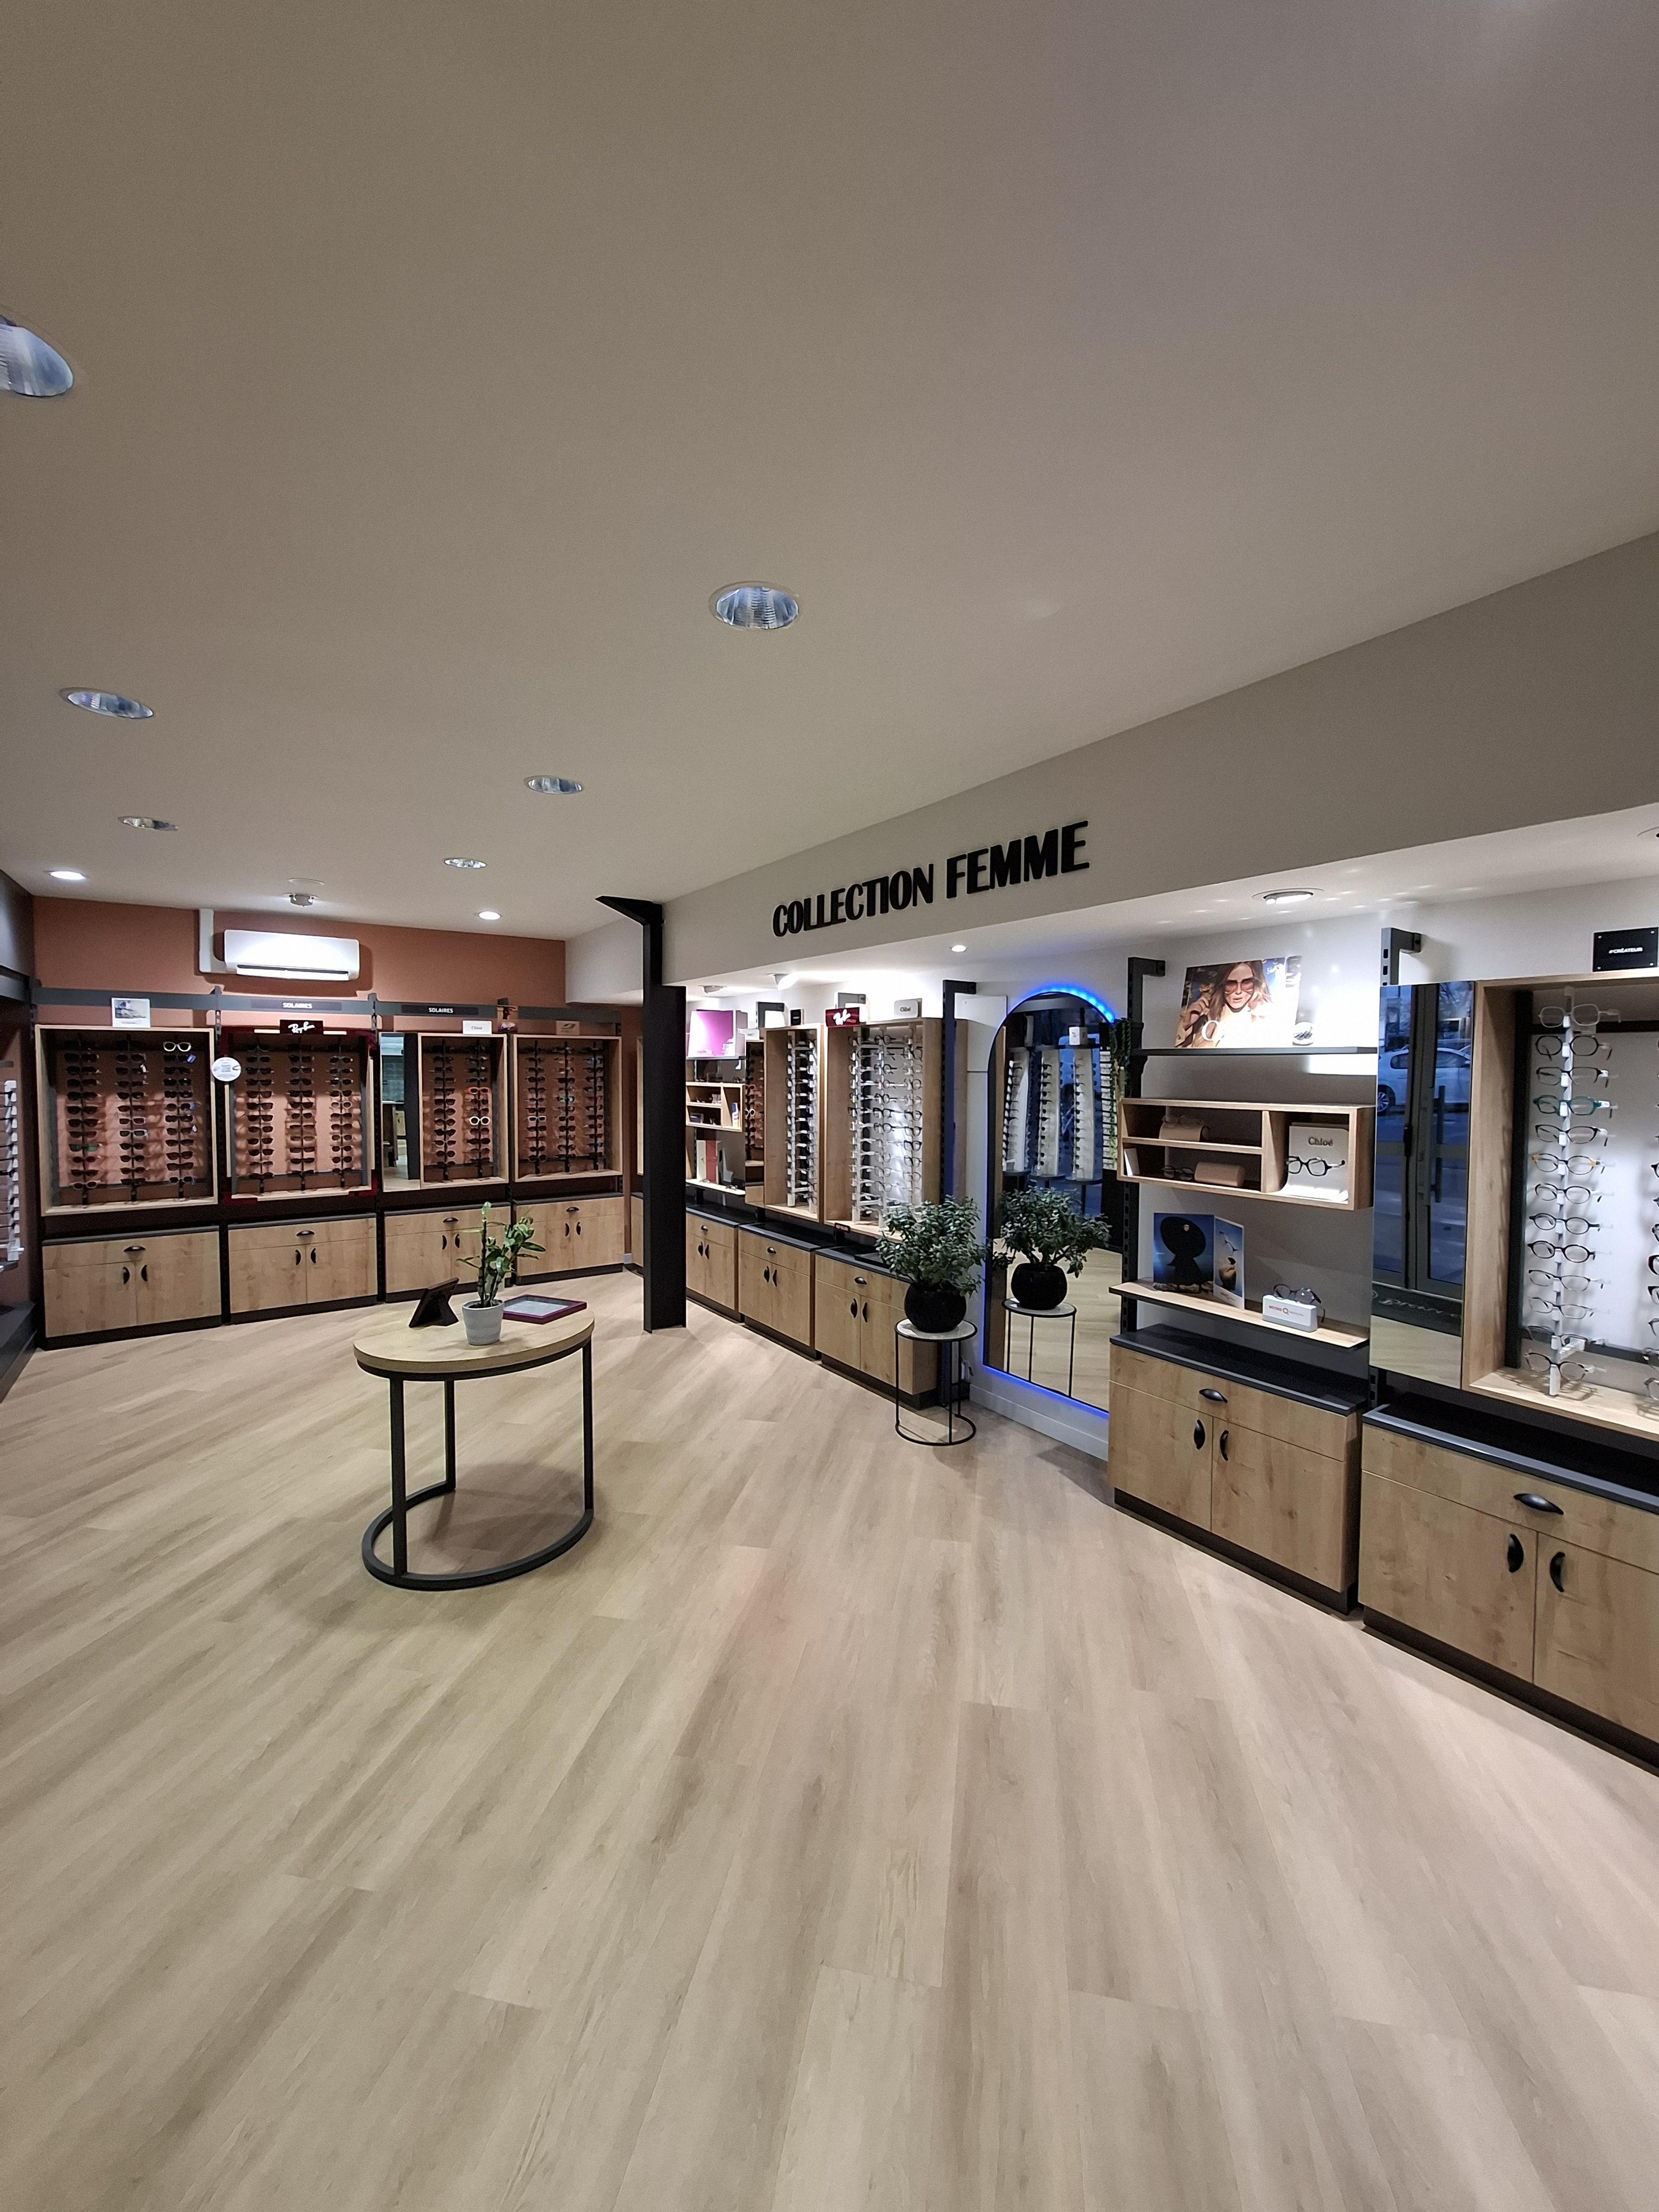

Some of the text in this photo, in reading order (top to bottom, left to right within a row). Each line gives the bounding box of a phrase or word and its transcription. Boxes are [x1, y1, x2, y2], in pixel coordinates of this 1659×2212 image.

[773, 820, 1090, 937] COLLECTION FEMME
[1308, 1137, 1333, 1147] Chloé
